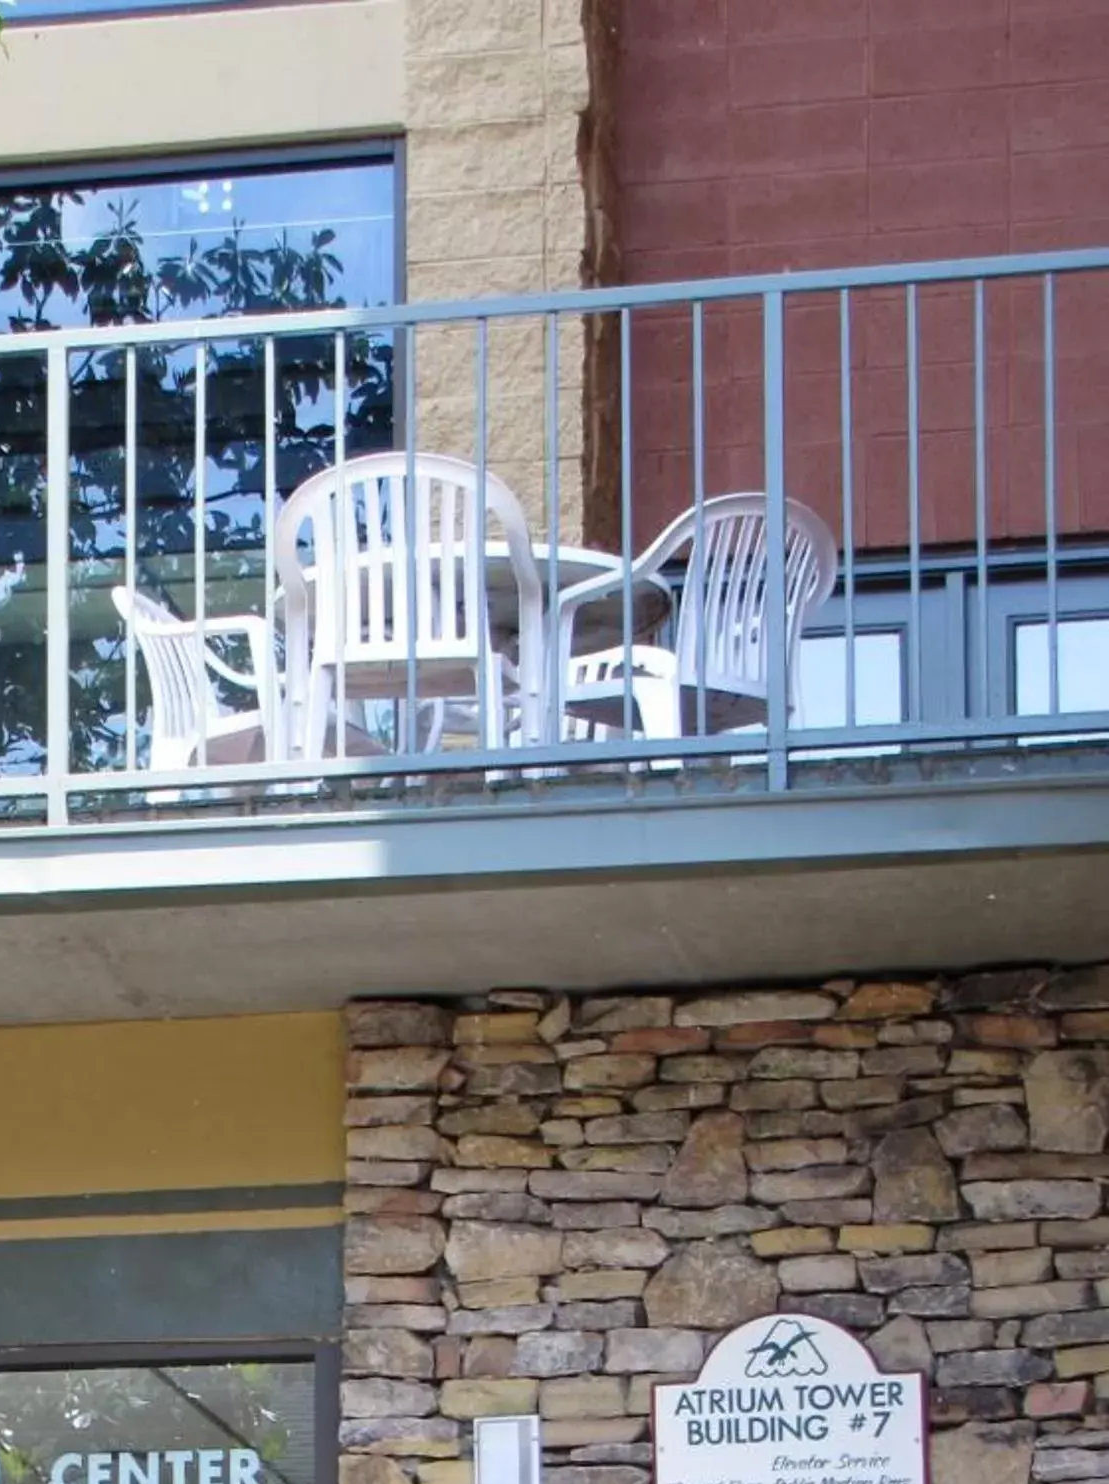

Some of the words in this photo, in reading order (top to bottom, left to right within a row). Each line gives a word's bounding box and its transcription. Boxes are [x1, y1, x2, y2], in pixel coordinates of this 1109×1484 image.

[675, 1387, 785, 1416] ATRIUM
[794, 1381, 904, 1410] TOWER
[687, 1415, 829, 1445] BUILDING
[848, 1412, 891, 1438] #7
[772, 1455, 831, 1471] Elevator
[835, 1453, 891, 1470] Service
